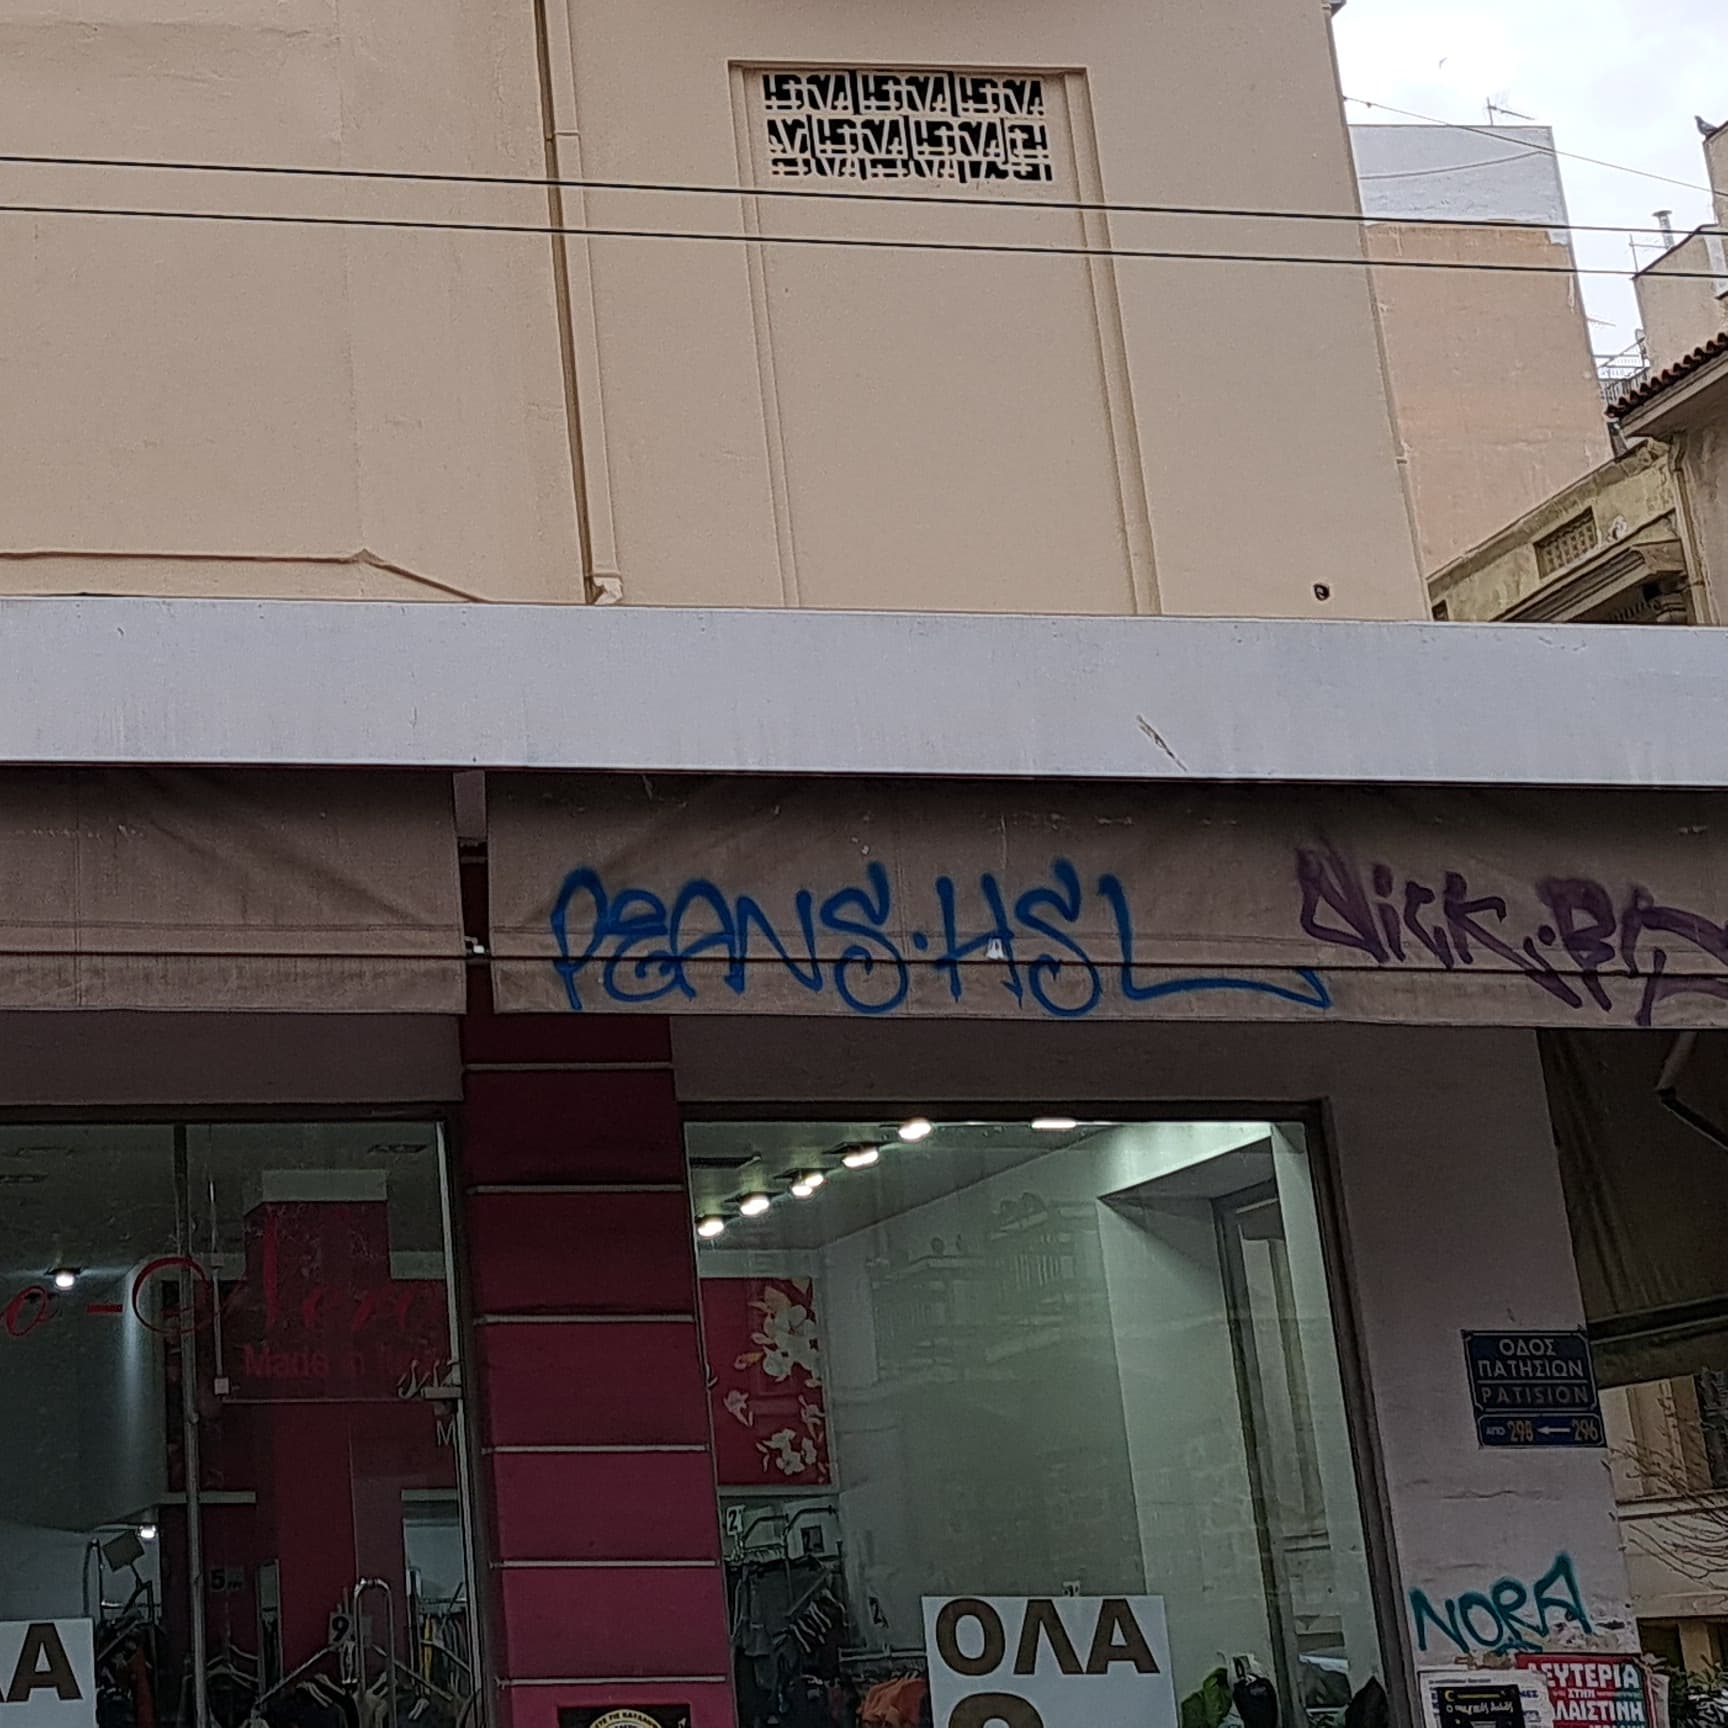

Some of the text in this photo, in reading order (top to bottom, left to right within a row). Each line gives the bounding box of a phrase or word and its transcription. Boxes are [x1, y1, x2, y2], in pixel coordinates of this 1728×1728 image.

[1498, 1338, 1557, 1357] ΟΔΟΣ
[1477, 1359, 1585, 1378] ΠΑΤΗΣΙΩΝ
[1480, 1385, 1589, 1405] PATISION
[1571, 1419, 1599, 1441] 296
[935, 1598, 1162, 1676] ΟΛΑ
[1554, 1700, 1646, 1721] ΛΑΙΣΤΙΝΗ
